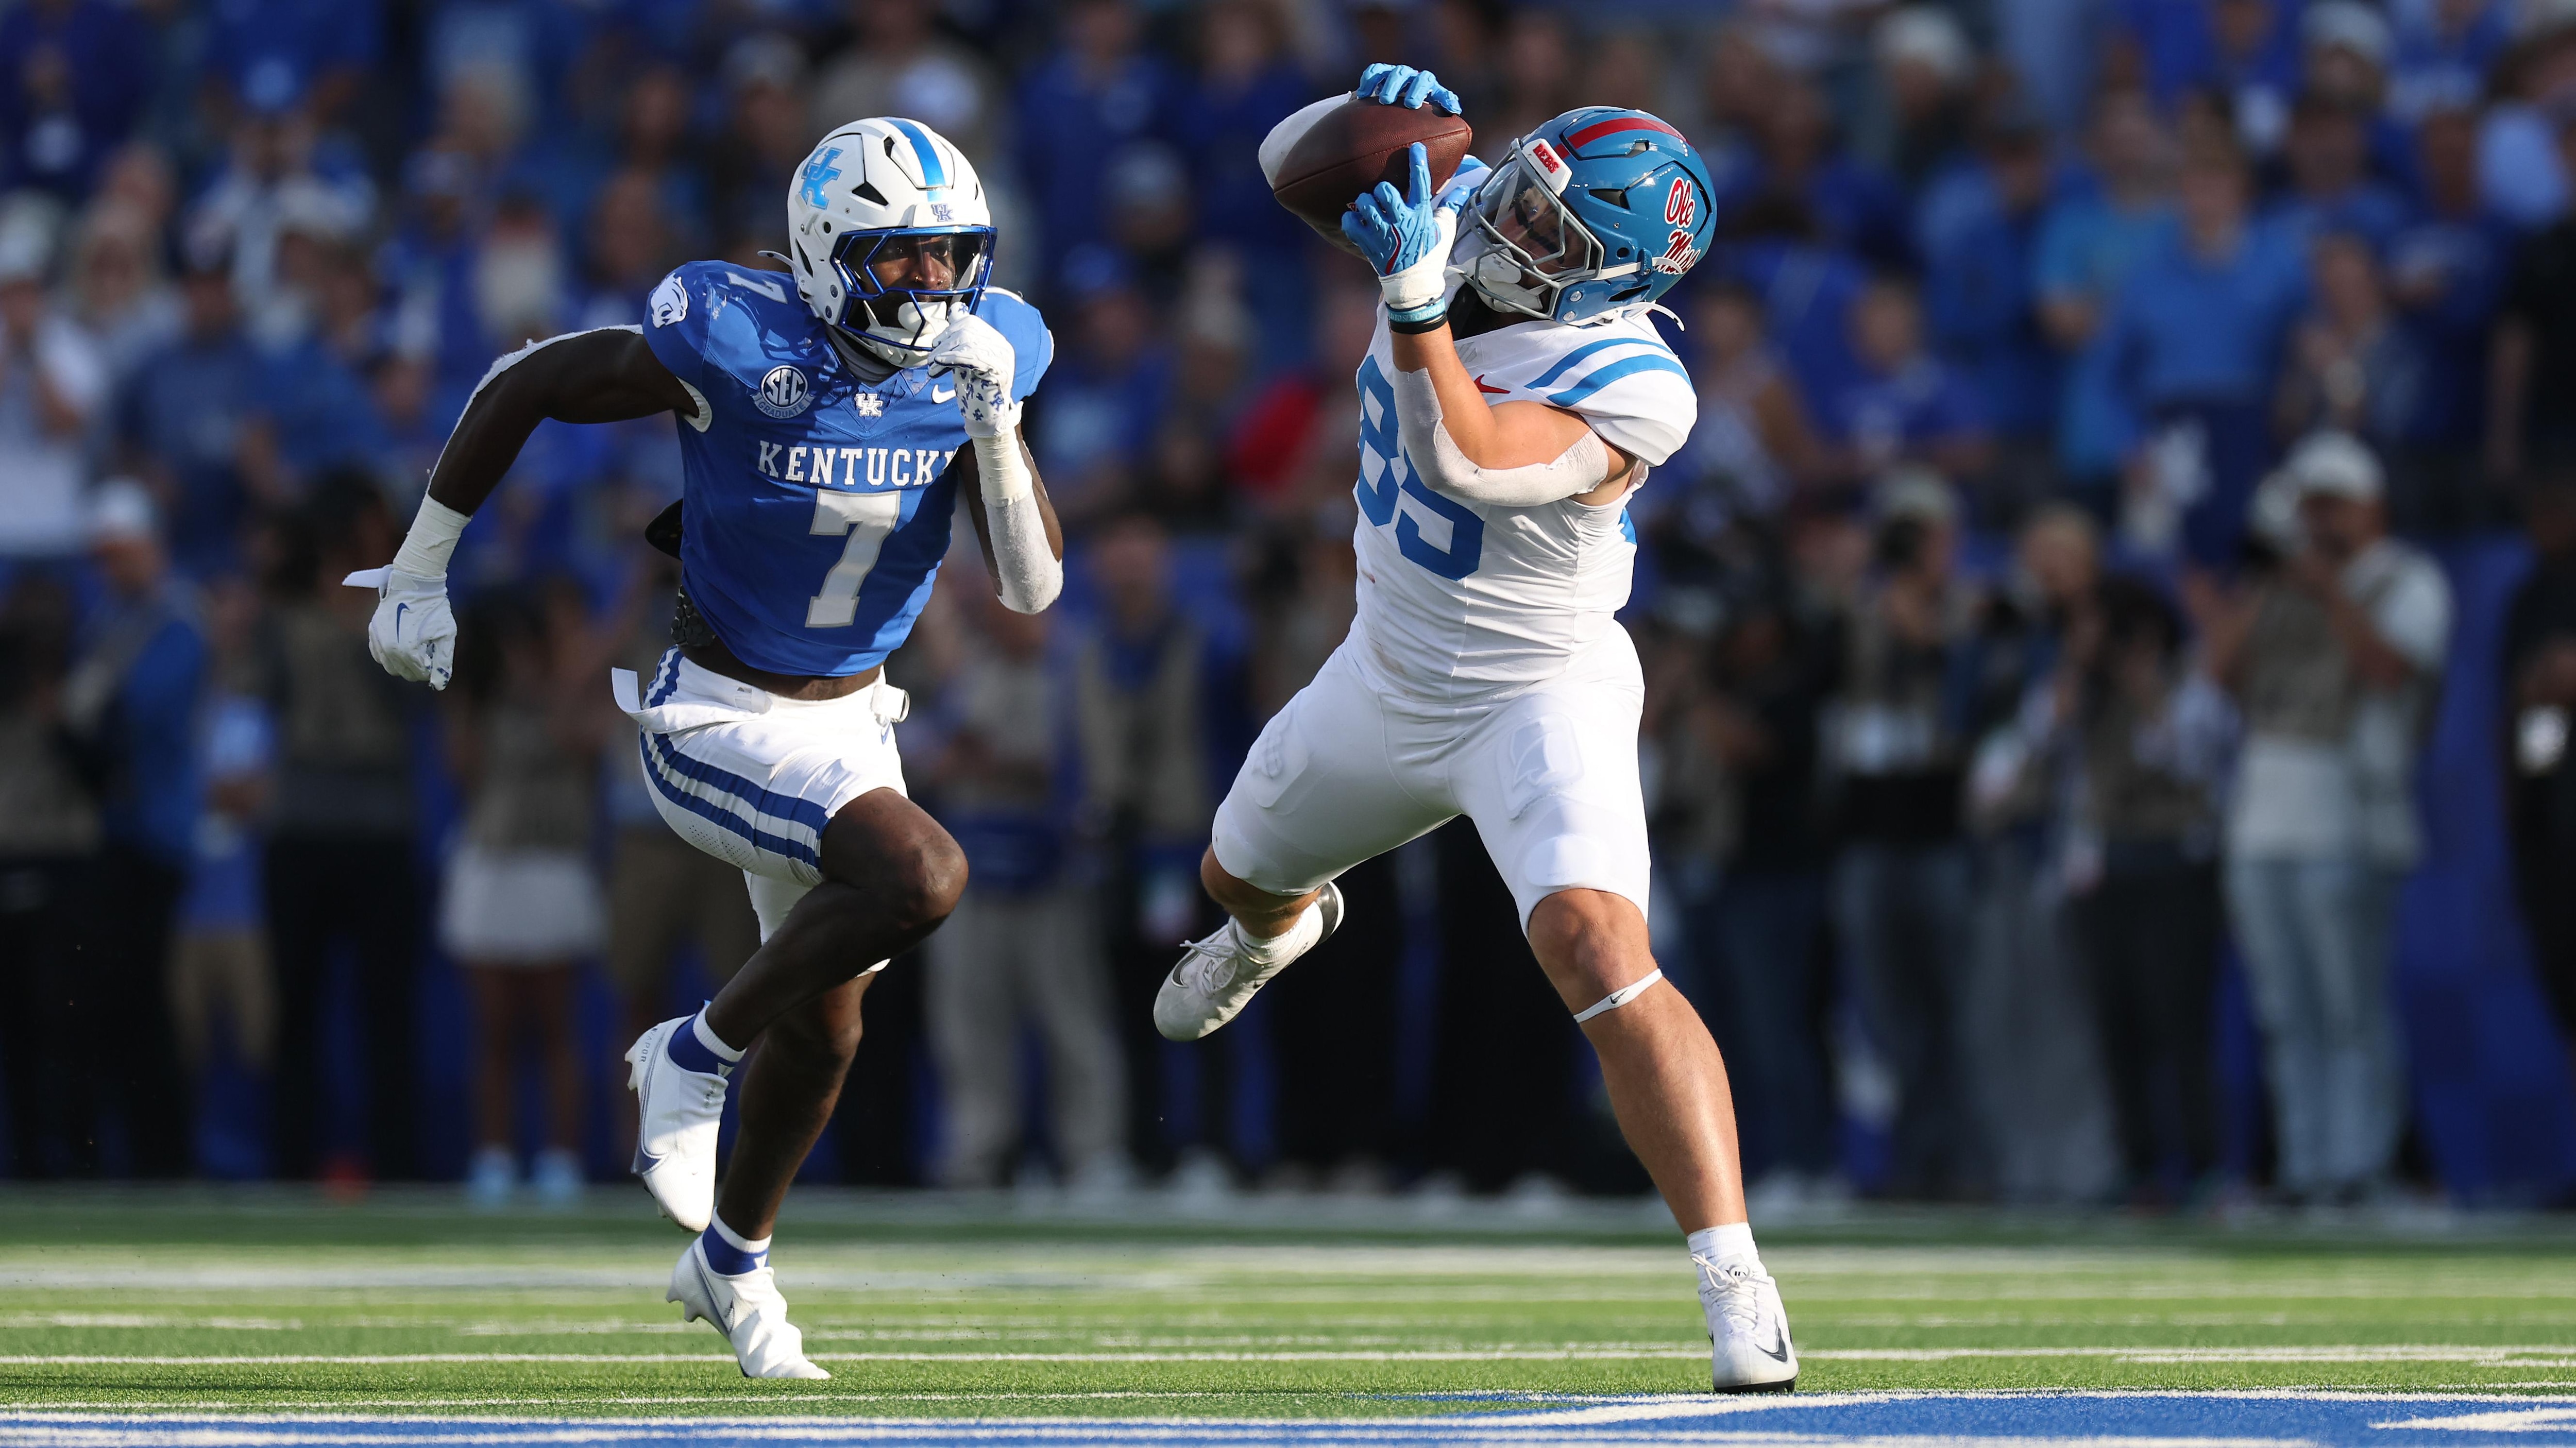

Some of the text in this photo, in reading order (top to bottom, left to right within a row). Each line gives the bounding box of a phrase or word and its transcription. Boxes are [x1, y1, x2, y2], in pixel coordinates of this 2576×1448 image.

[798, 146, 843, 210] UK
[1533, 143, 1560, 173] REBS
[930, 203, 954, 222] UK
[1665, 177, 1695, 228] Ole
[1653, 229, 1701, 274] Miss
[766, 368, 804, 405] SEC
[855, 394, 884, 417] UK
[758, 401, 806, 418] GRADUATE
[1357, 354, 1485, 581] 85
[805, 488, 901, 628] 7
